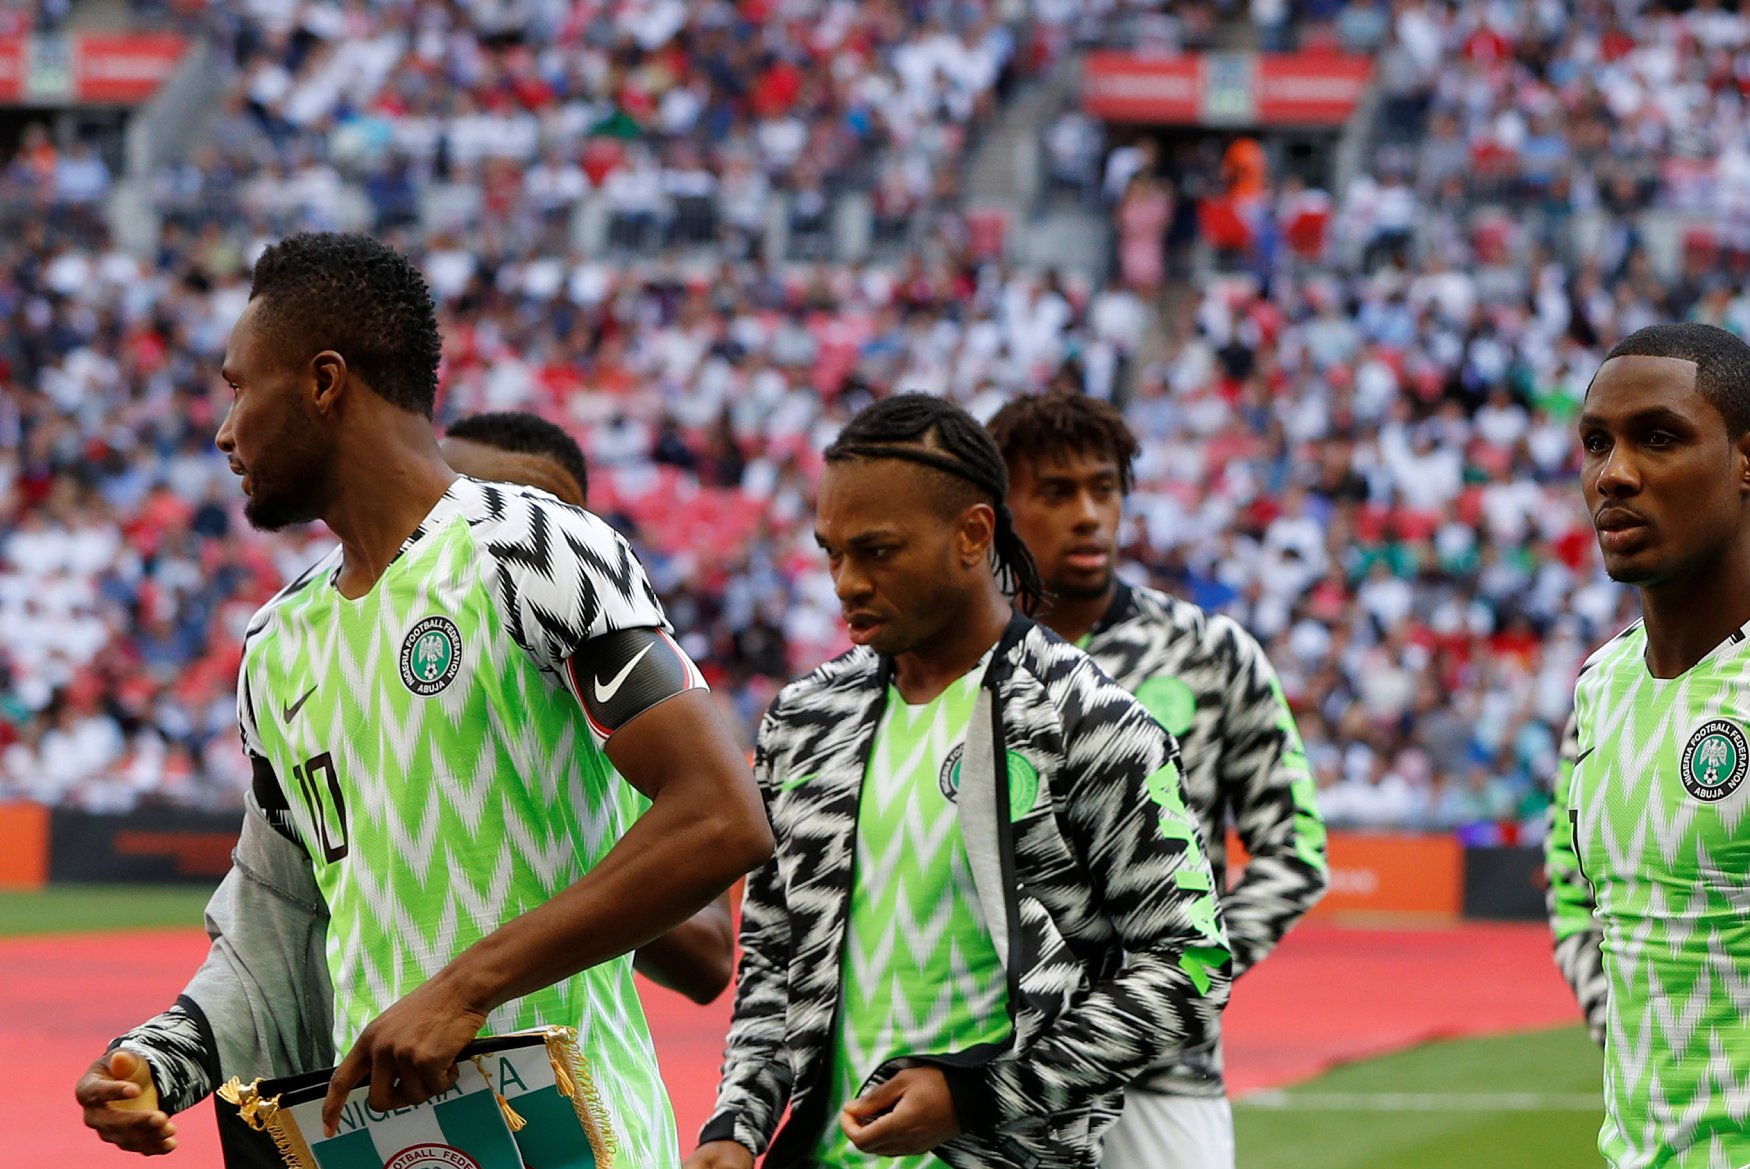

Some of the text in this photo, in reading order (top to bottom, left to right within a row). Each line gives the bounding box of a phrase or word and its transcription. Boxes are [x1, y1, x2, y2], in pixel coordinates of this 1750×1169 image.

[401, 619, 461, 687] NIGERIA FOOTBALL FEDERATION
[416, 680, 445, 693] ABUJA
[1682, 723, 1747, 789] NIGERIA FOOTBALL FEDERATION
[292, 751, 349, 865] 10
[1693, 787, 1725, 798] ABUJA
